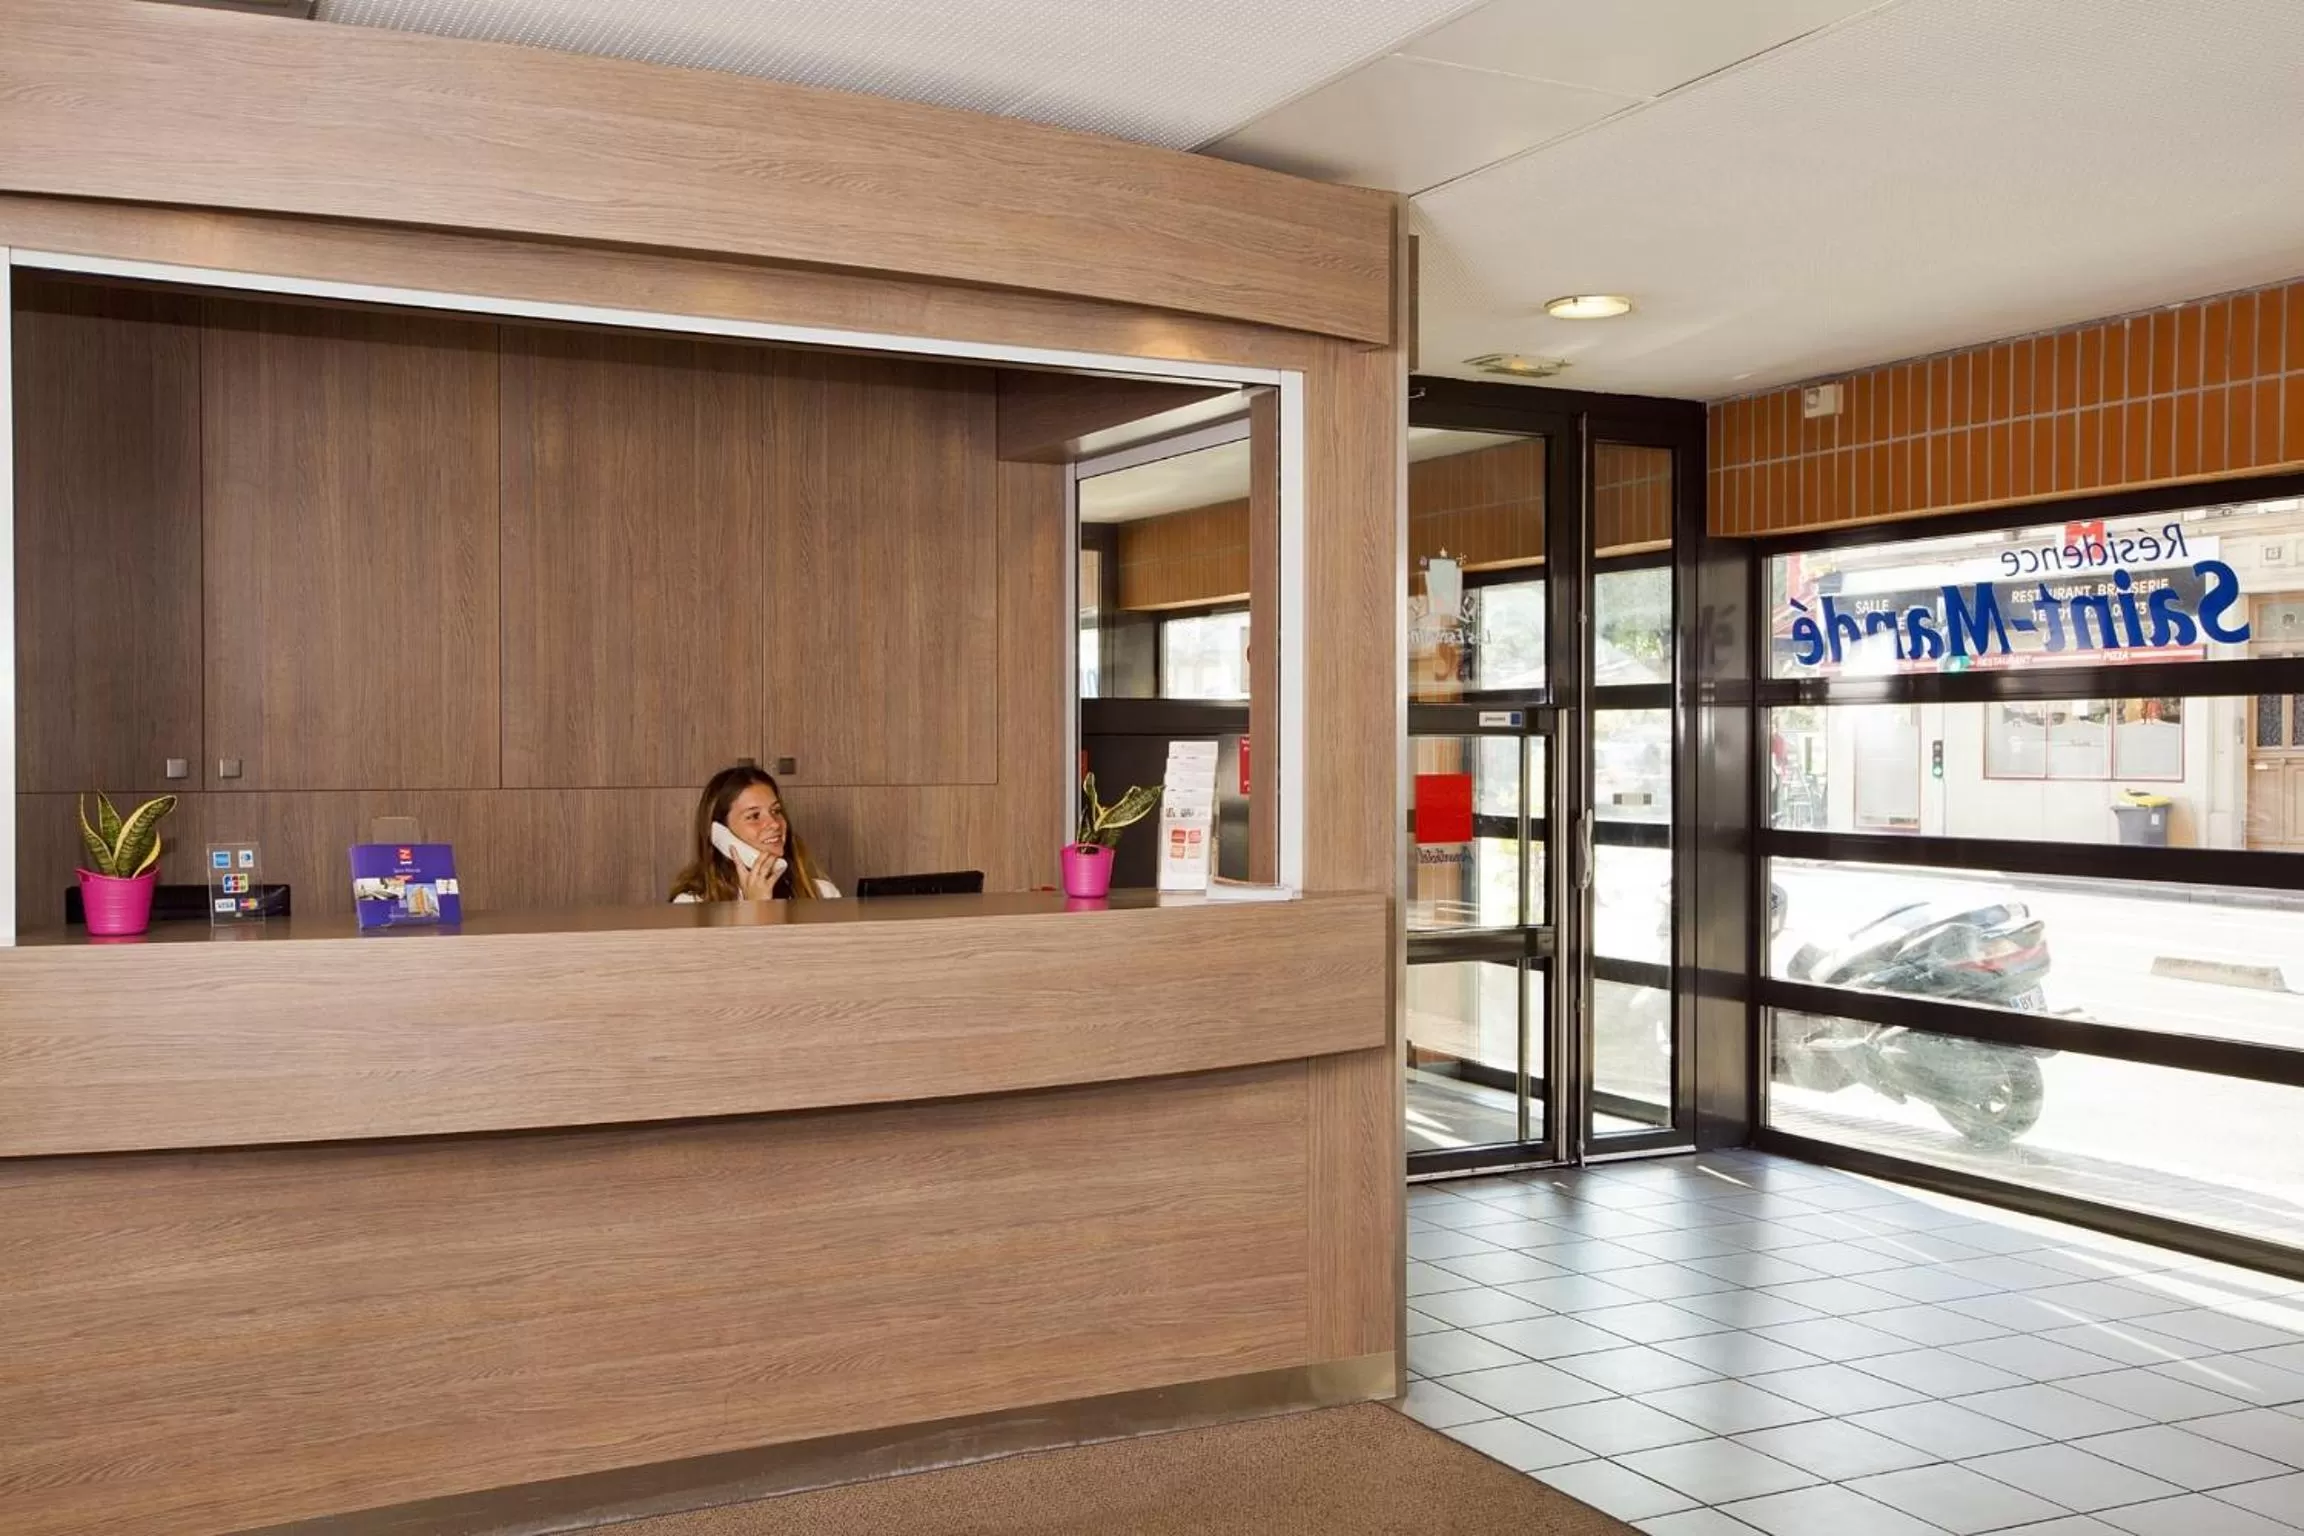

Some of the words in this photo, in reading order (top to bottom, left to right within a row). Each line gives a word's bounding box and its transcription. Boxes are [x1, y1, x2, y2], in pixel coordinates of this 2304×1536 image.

[2011, 584, 2092, 604] RESTURANT
[2097, 578, 2169, 597] BRSERIE
[1855, 599, 1889, 615] SALLE
